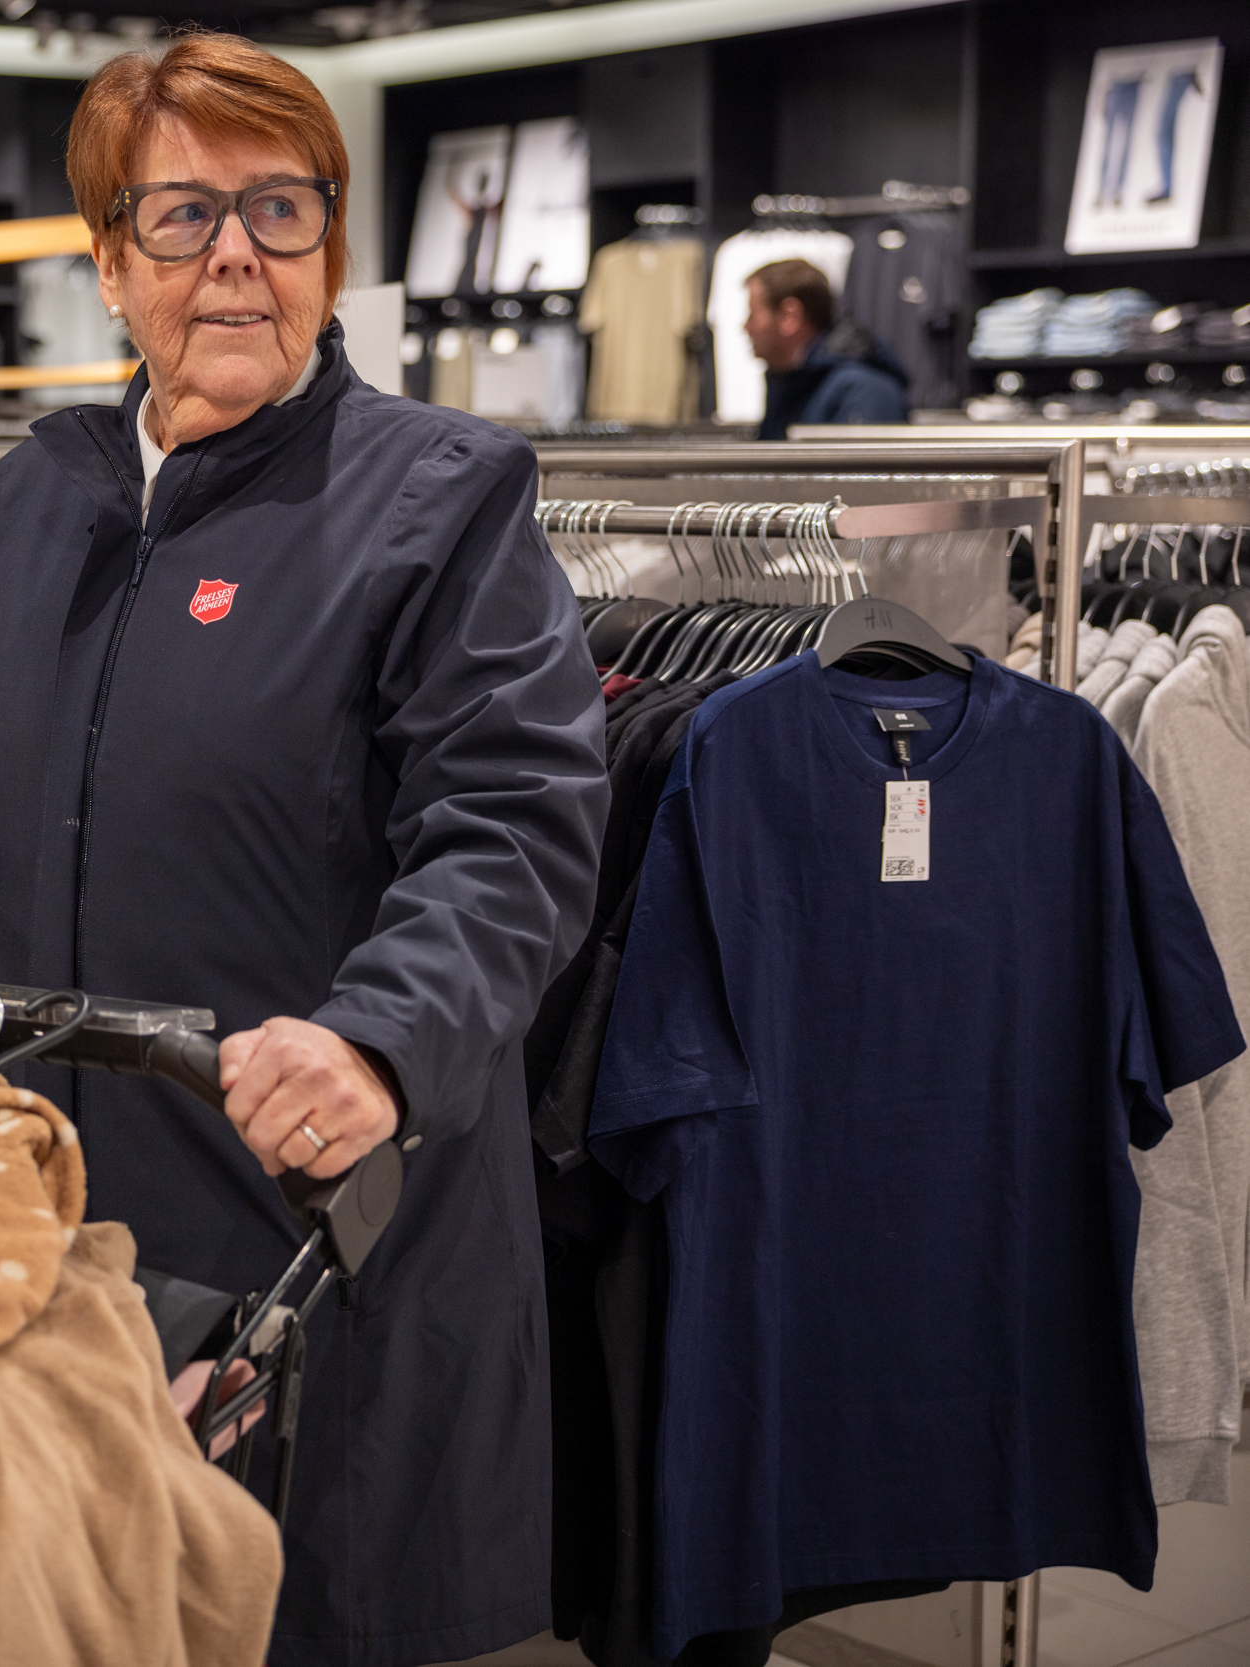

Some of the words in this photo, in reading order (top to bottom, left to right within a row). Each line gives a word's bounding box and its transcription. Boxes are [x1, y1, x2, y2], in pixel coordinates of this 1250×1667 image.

[195, 597, 230, 614] ARMEEN
[863, 607, 894, 630] HM
[917, 798, 926, 816] HM
